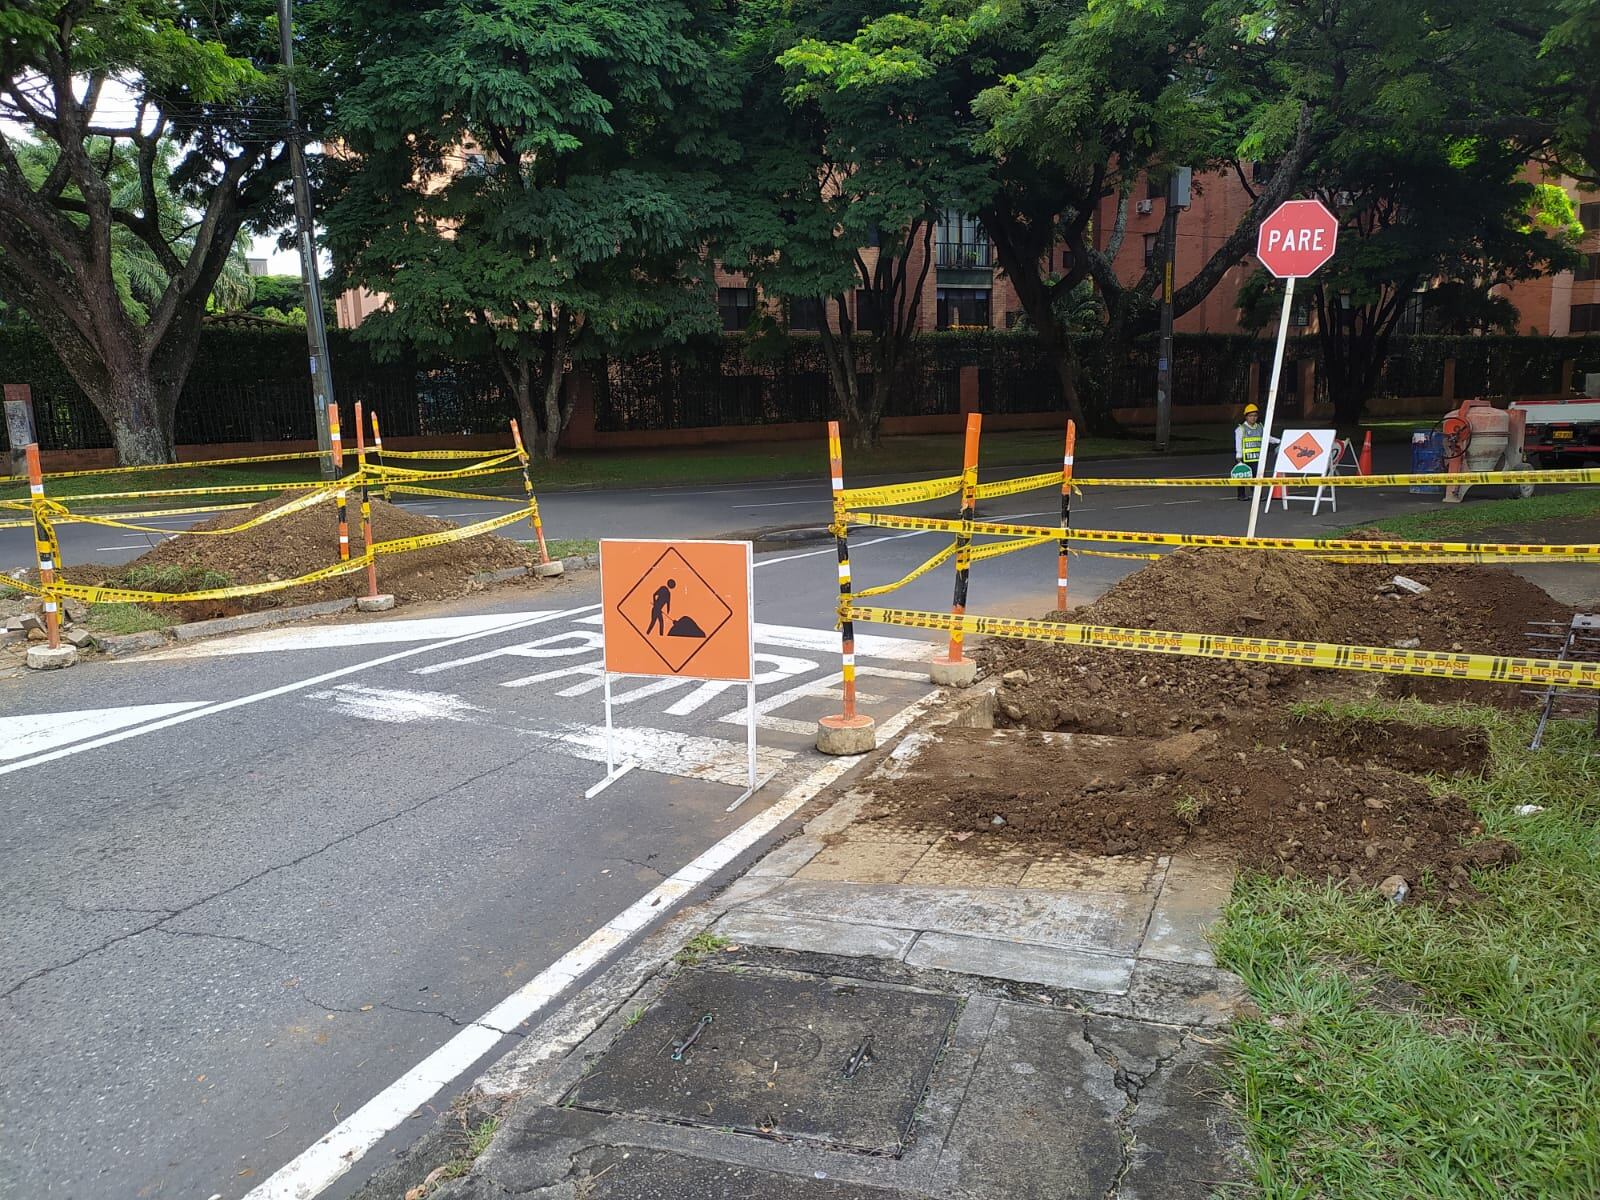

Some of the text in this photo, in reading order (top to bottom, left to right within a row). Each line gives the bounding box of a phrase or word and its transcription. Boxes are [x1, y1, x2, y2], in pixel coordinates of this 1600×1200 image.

[1268, 229, 1325, 252] PARE
[987, 623, 1024, 633] PELIGRO
[1029, 627, 1042, 635] NO
[1094, 632, 1184, 647] PELIGRO NO PASE
[1215, 642, 1316, 658] PELIGRO NO PASE
[1353, 653, 1469, 671] PELIGRO NO PASE
[1512, 666, 1573, 679] PELIGRO
